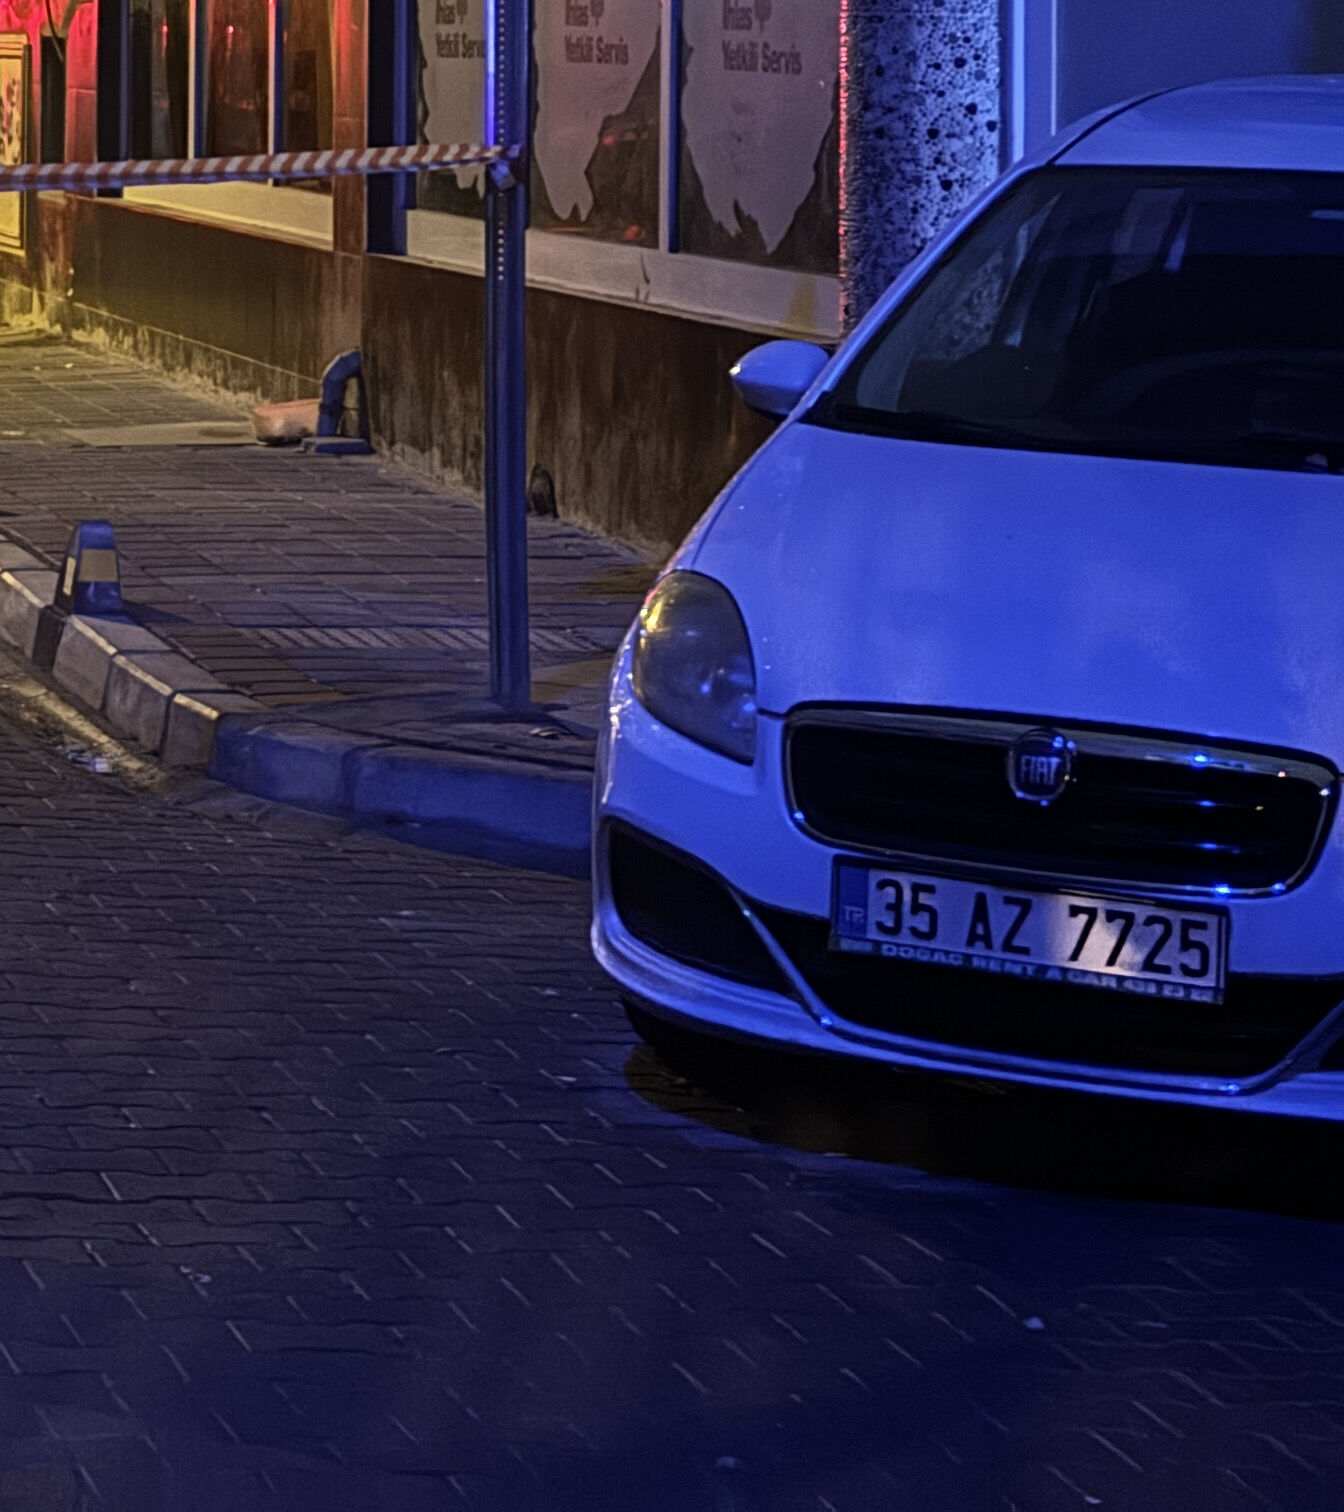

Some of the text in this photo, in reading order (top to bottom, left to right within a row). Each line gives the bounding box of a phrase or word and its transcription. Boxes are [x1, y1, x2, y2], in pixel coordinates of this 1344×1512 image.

[564, 36, 629, 65] Yetkili Servis
[722, 40, 802, 75] Yetkili Servis
[1021, 754, 1061, 785] FIAT
[875, 878, 1210, 978] 35 AZ 7725
